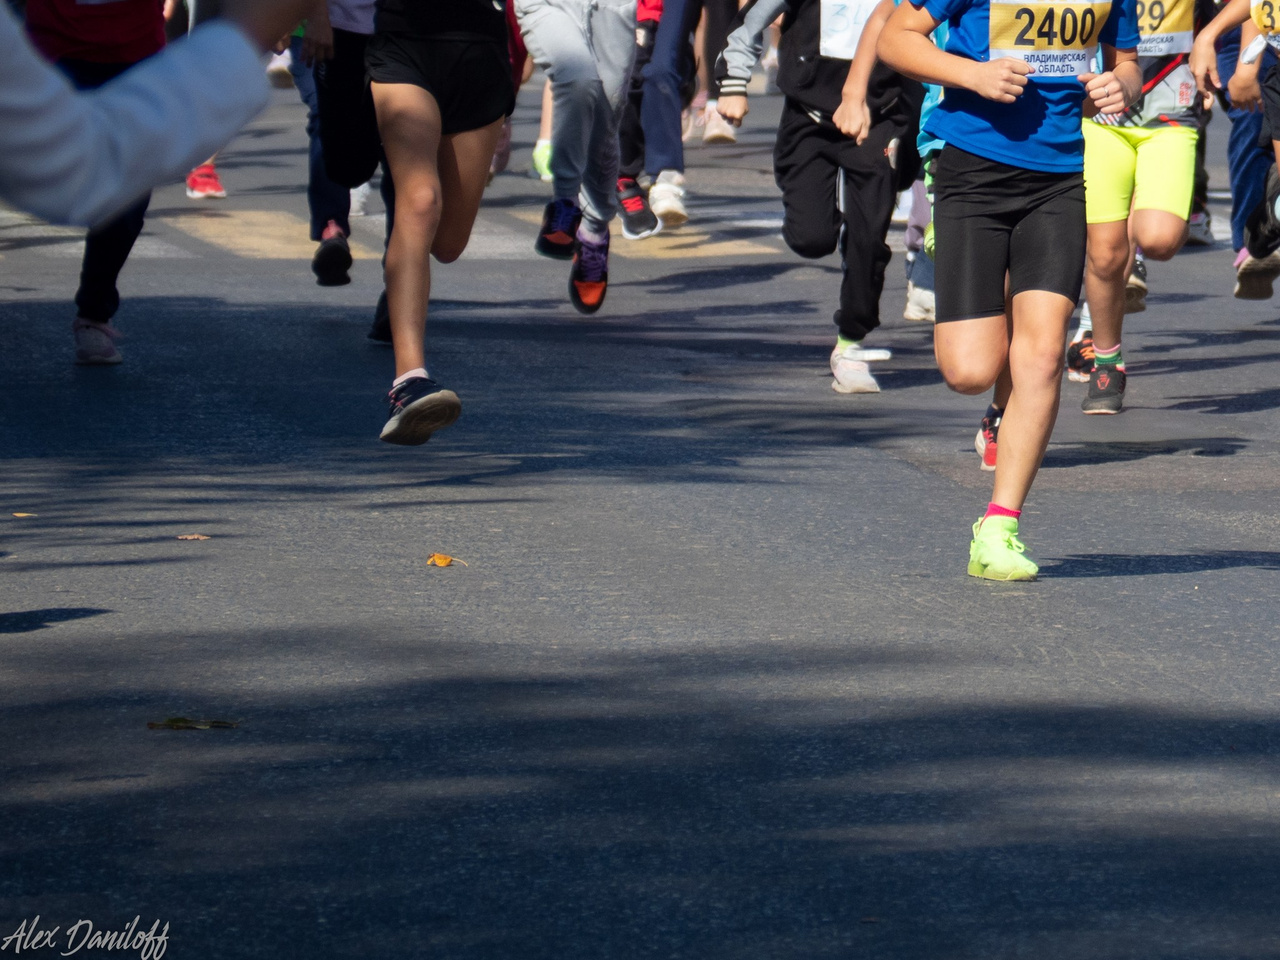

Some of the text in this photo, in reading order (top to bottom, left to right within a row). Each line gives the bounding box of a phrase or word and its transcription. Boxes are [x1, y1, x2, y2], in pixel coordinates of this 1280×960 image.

[1014, 7, 1096, 46] 2400
[1024, 53, 1087, 64] ВЛАДИМИРСКАЯ
[1038, 64, 1075, 74] ОБЛАСТЬ
